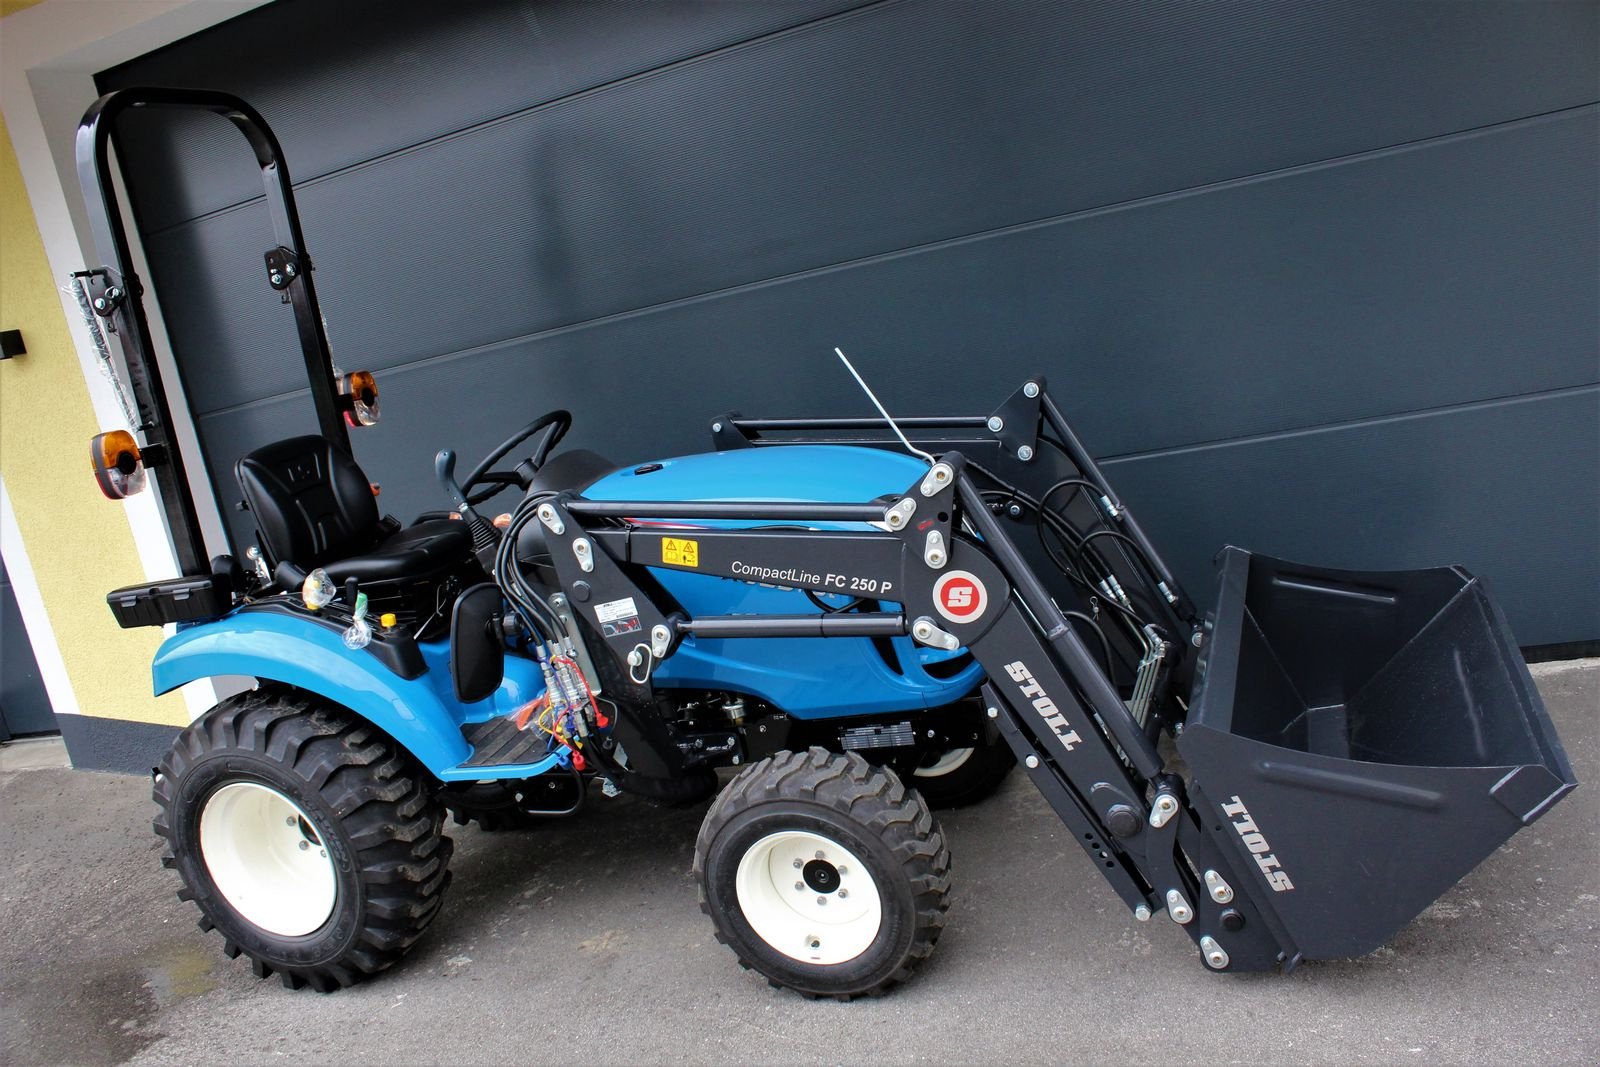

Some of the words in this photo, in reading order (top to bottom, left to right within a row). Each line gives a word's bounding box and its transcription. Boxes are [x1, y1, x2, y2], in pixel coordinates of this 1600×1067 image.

[731, 561, 820, 584] CompactLine
[825, 573, 847, 588] FC
[850, 577, 877, 592] 250
[880, 581, 893, 594] P
[947, 586, 973, 607] S
[1003, 660, 1083, 751] STOLL
[1221, 795, 1295, 892] STOLL
